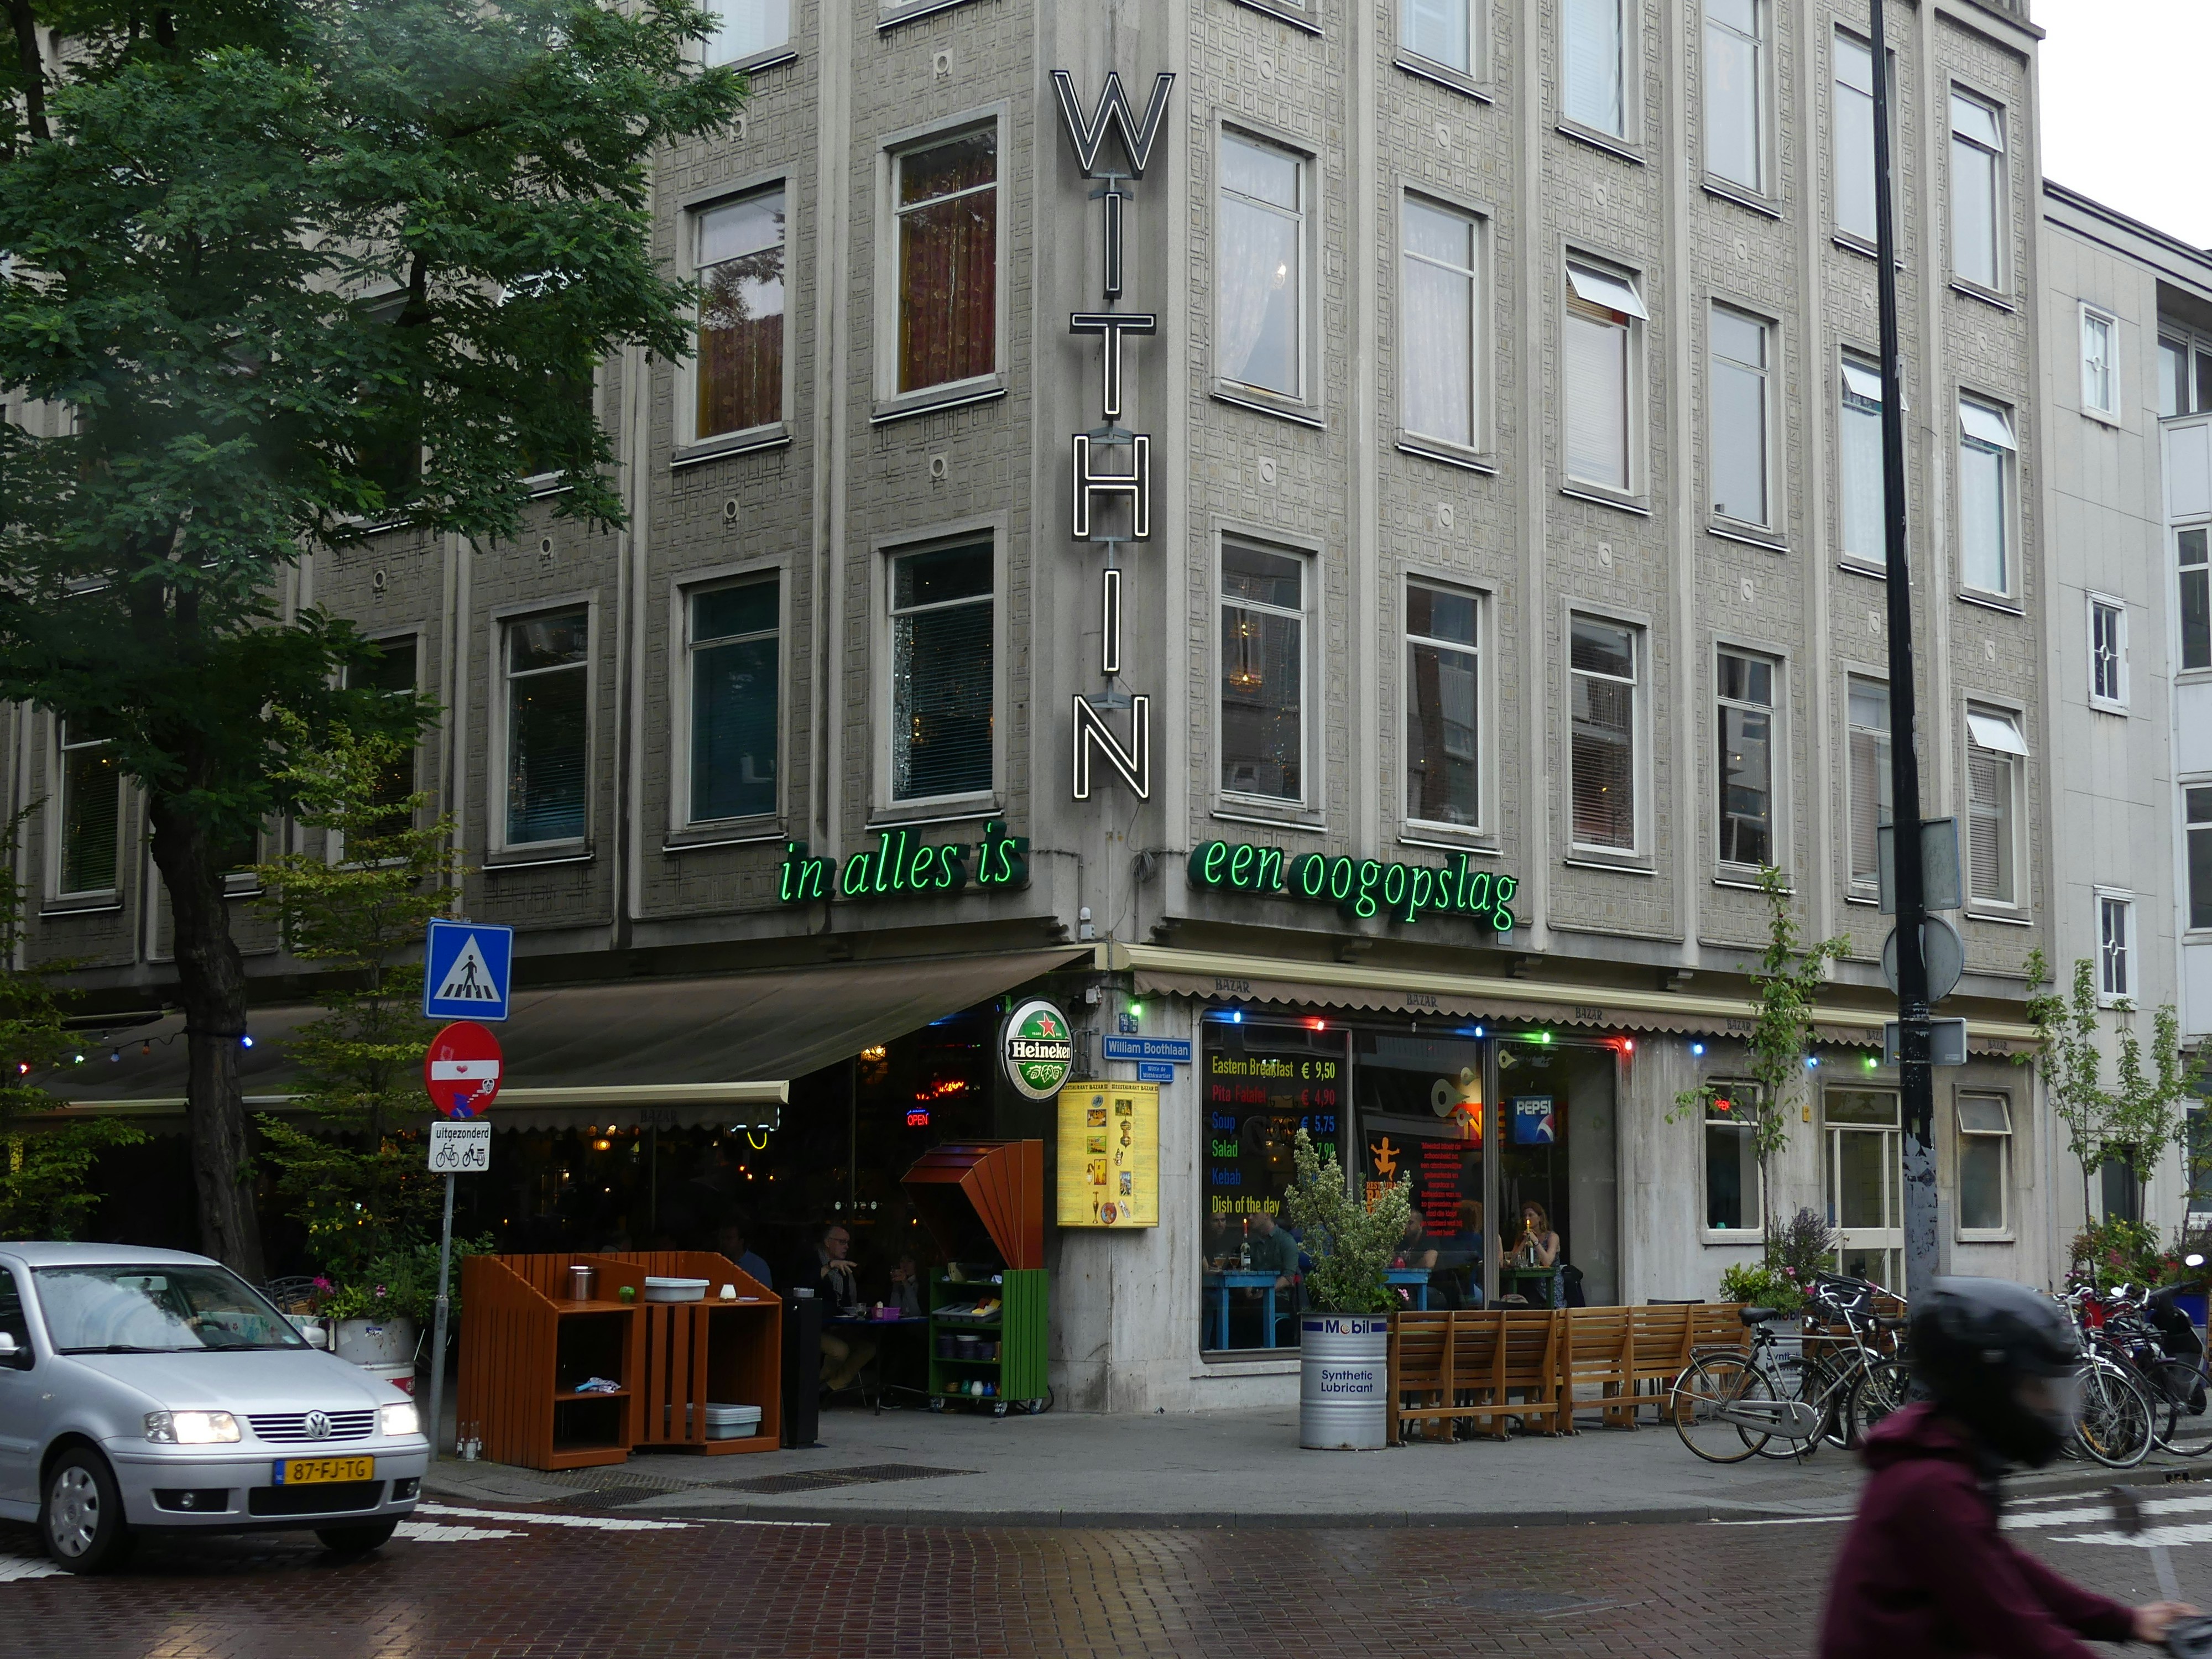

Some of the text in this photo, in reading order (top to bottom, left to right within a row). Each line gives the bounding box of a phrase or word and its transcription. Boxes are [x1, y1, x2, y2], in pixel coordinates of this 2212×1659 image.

[1048, 70, 1176, 802] WITHIN
[775, 821, 1023, 901] in alles is
[1197, 841, 1518, 932] een oogopslag
[1215, 978, 1251, 994] BAZAR
[1406, 993, 1438, 1008] BAZAR
[1575, 1007, 1603, 1020] BAZAR
[1726, 1019, 1751, 1032] BAZAR
[1866, 1029, 1884, 1041] BAZA
[1013, 1041, 1071, 1059] Heineken
[1108, 1040, 1188, 1056] William Boothlaan
[1987, 1039, 2008, 1051] BAZAR
[1212, 1056, 1335, 1081] Eastern Breakfast € 9,50
[1212, 1084, 1335, 1108] Pita Falafel € 4,90
[1516, 1099, 1551, 1115] PEPSI
[640, 1109, 678, 1123] BAZAR
[907, 1114, 928, 1126] OPEN
[1212, 1111, 1235, 1134] Soup
[1314, 1115, 1335, 1134] 5,75
[436, 1127, 490, 1142] uitgezonderd
[1212, 1140, 1238, 1157] Salad
[1212, 1168, 1241, 1186] Kebab
[1212, 1196, 1280, 1217] Dish of the day
[1322, 1369, 1373, 1381] Synthetic
[1321, 1382, 1373, 1392] Lubricant
[293, 1460, 366, 1480] 87-FJ-TG
